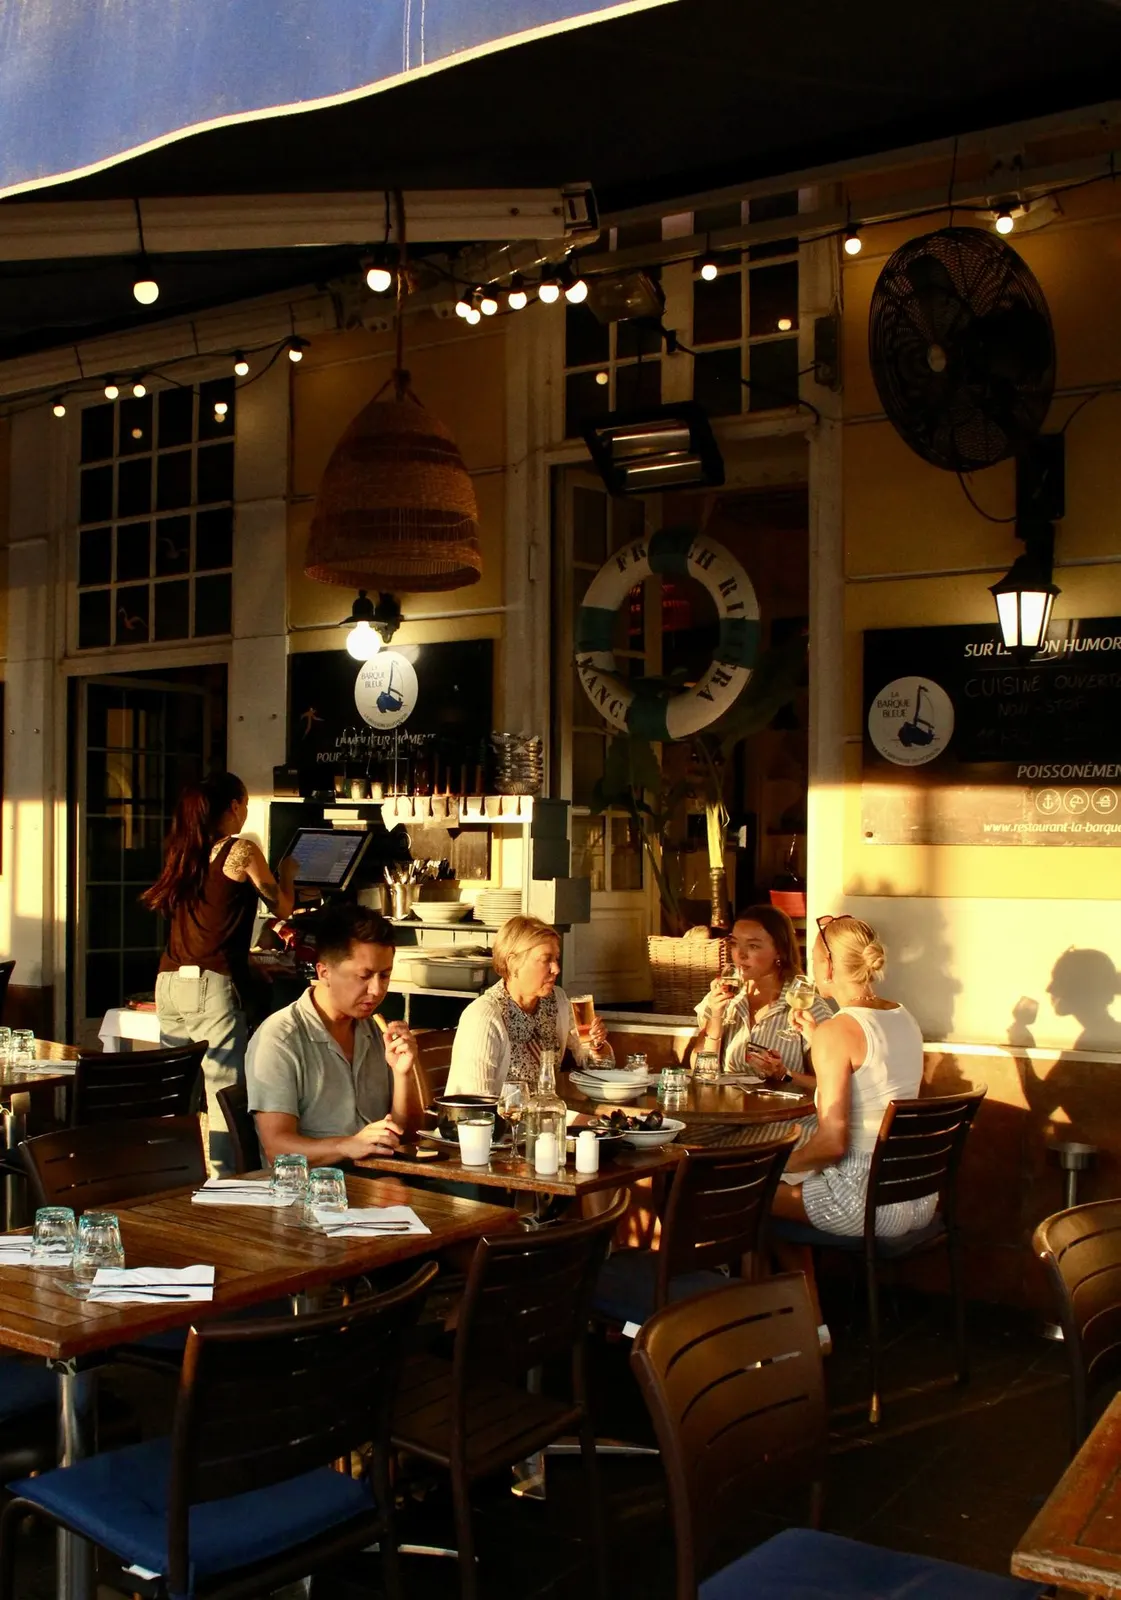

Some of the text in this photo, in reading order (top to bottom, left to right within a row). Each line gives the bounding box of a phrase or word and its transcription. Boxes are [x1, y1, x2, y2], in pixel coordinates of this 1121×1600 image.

[964, 642, 994, 657] SUR
[1063, 636, 1121, 653] HUMOR
[364, 679, 384, 688] BLEUE
[964, 675, 1041, 698] CUISINE
[877, 699, 911, 709] BARQUE
[882, 709, 907, 718] BLEUE
